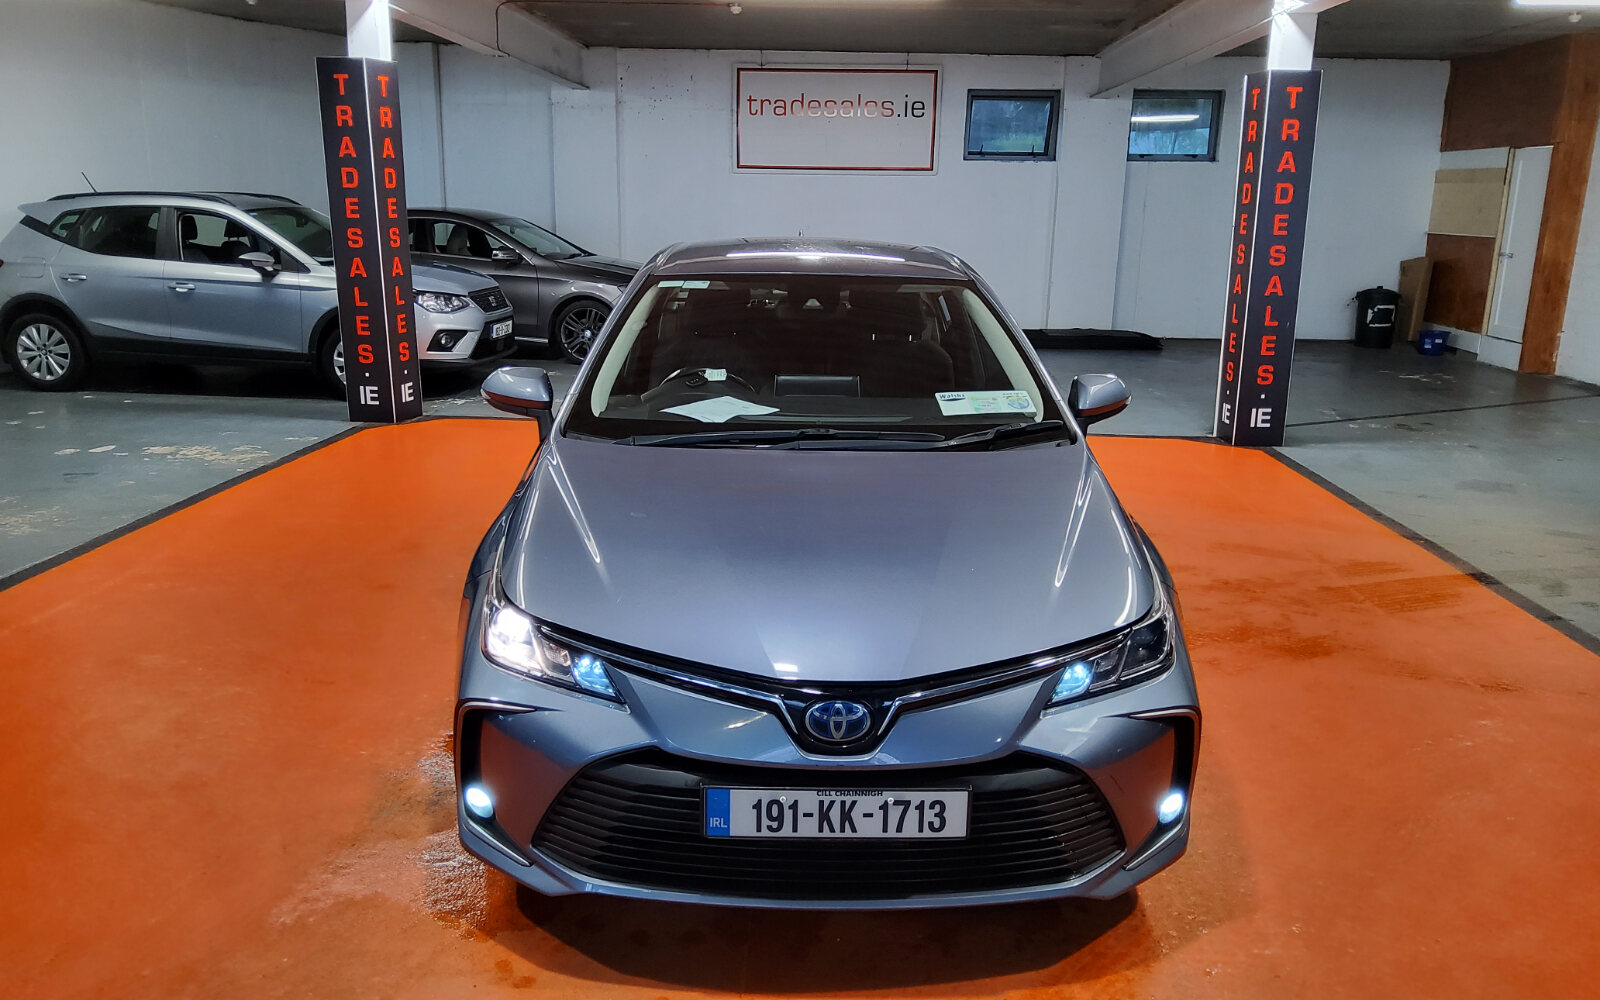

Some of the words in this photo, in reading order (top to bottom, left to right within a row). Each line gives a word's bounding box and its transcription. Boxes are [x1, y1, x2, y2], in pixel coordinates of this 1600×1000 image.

[747, 92, 926, 118] tradesales.ie
[709, 817, 728, 828] IRL
[751, 799, 947, 834] 191-KK-1713
